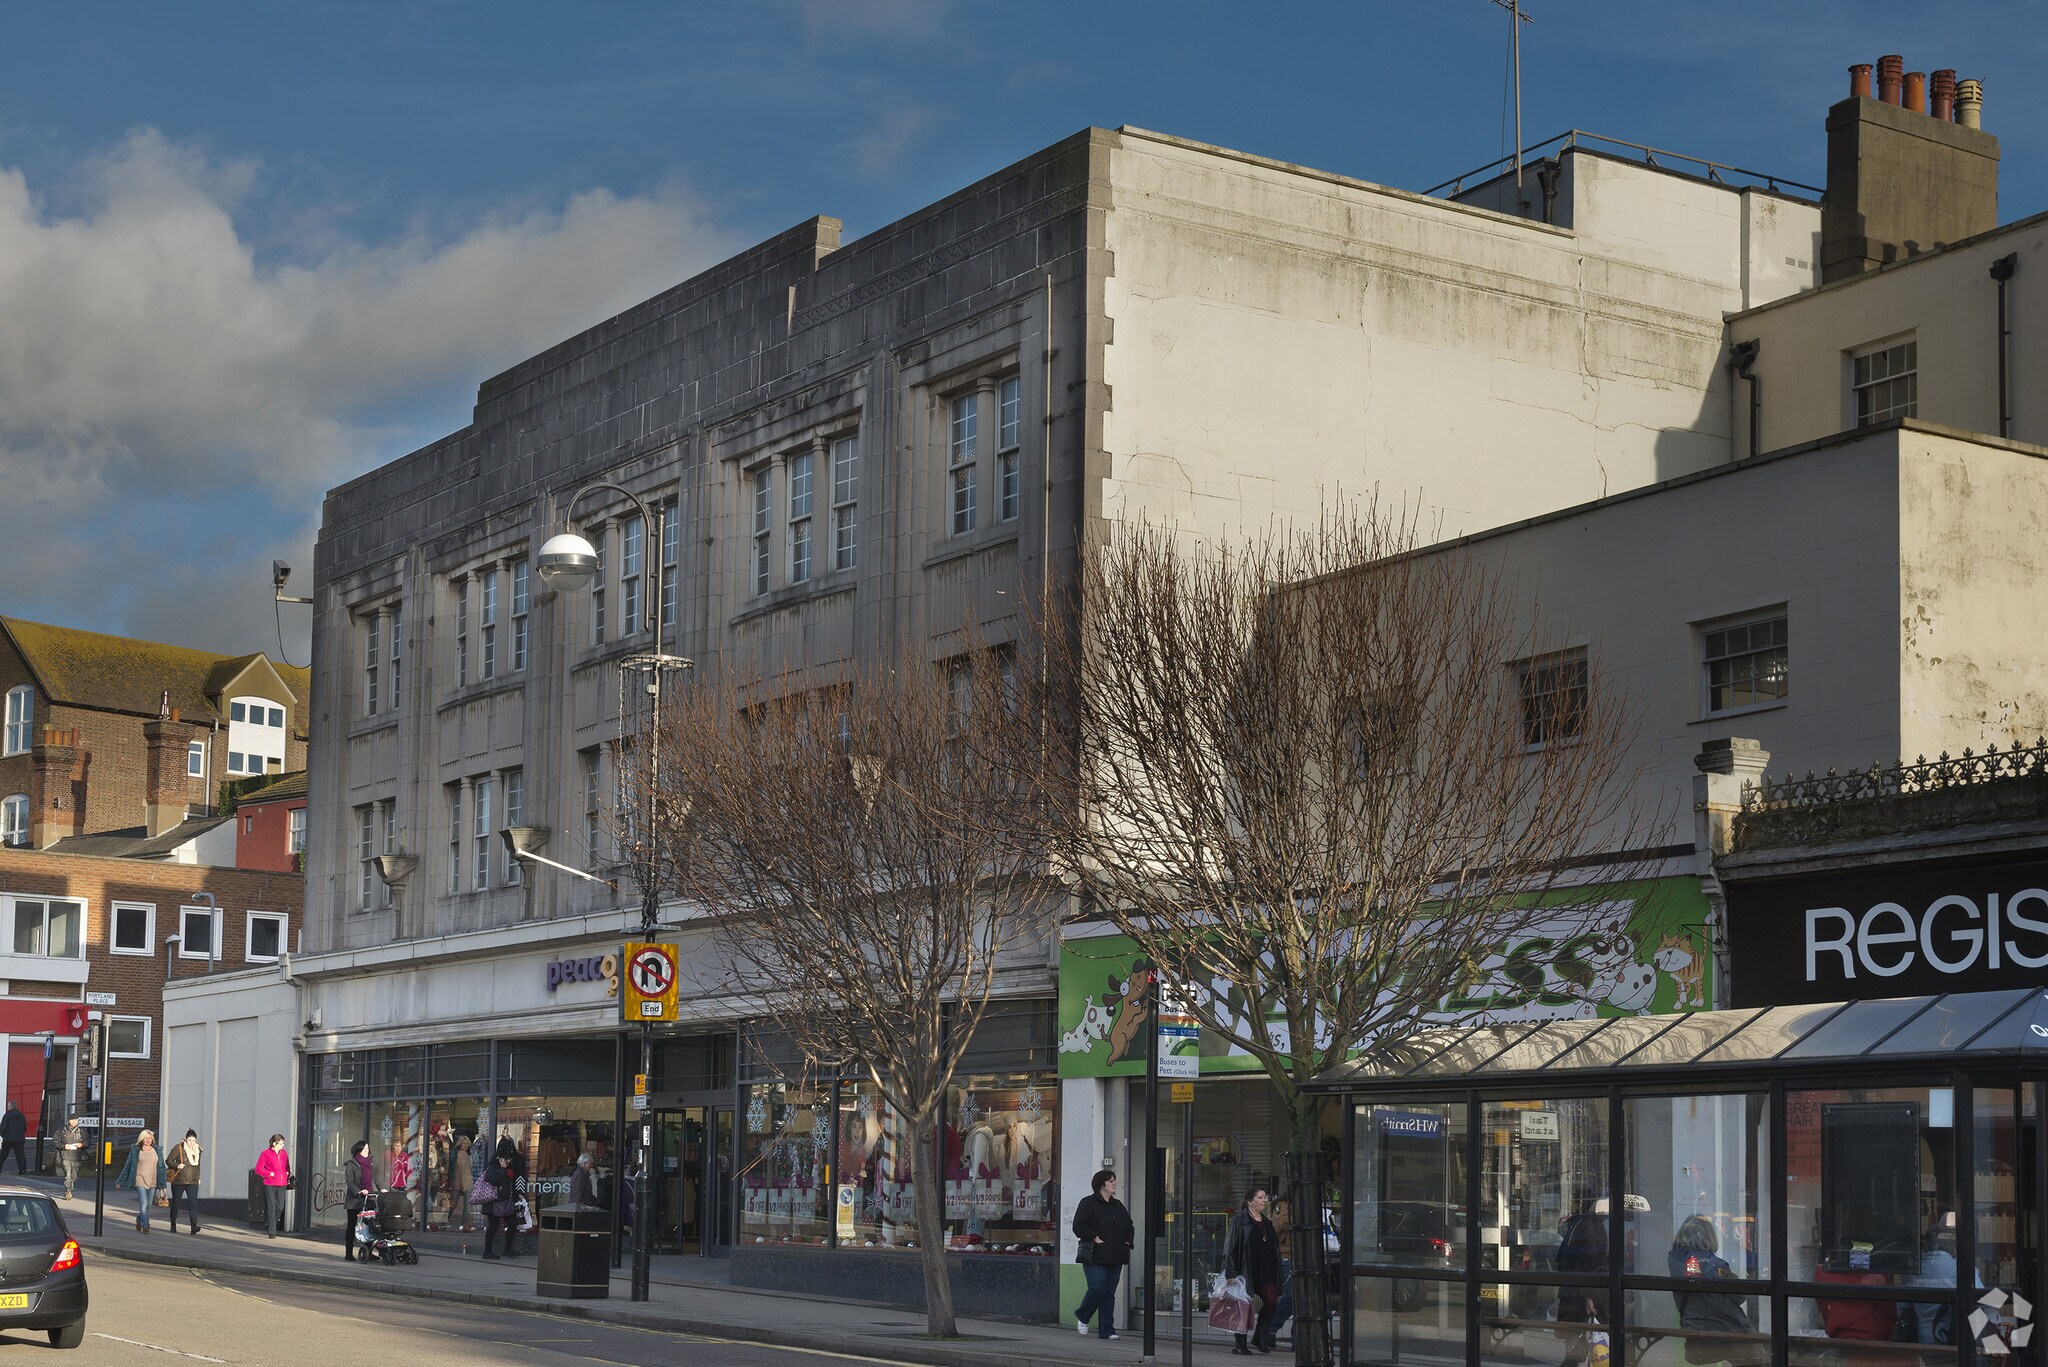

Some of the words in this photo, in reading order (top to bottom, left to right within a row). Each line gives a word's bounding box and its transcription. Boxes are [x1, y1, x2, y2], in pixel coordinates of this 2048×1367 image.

[644, 1005, 660, 1013] End
[1160, 1057, 1177, 1065] Buses
[1160, 1066, 1172, 1074] Pett
[527, 1182, 571, 1193] mens
[902, 1197, 914, 1209] OFF
[1027, 1196, 1039, 1209] OFF
[0, 1296, 23, 1306] XZD
